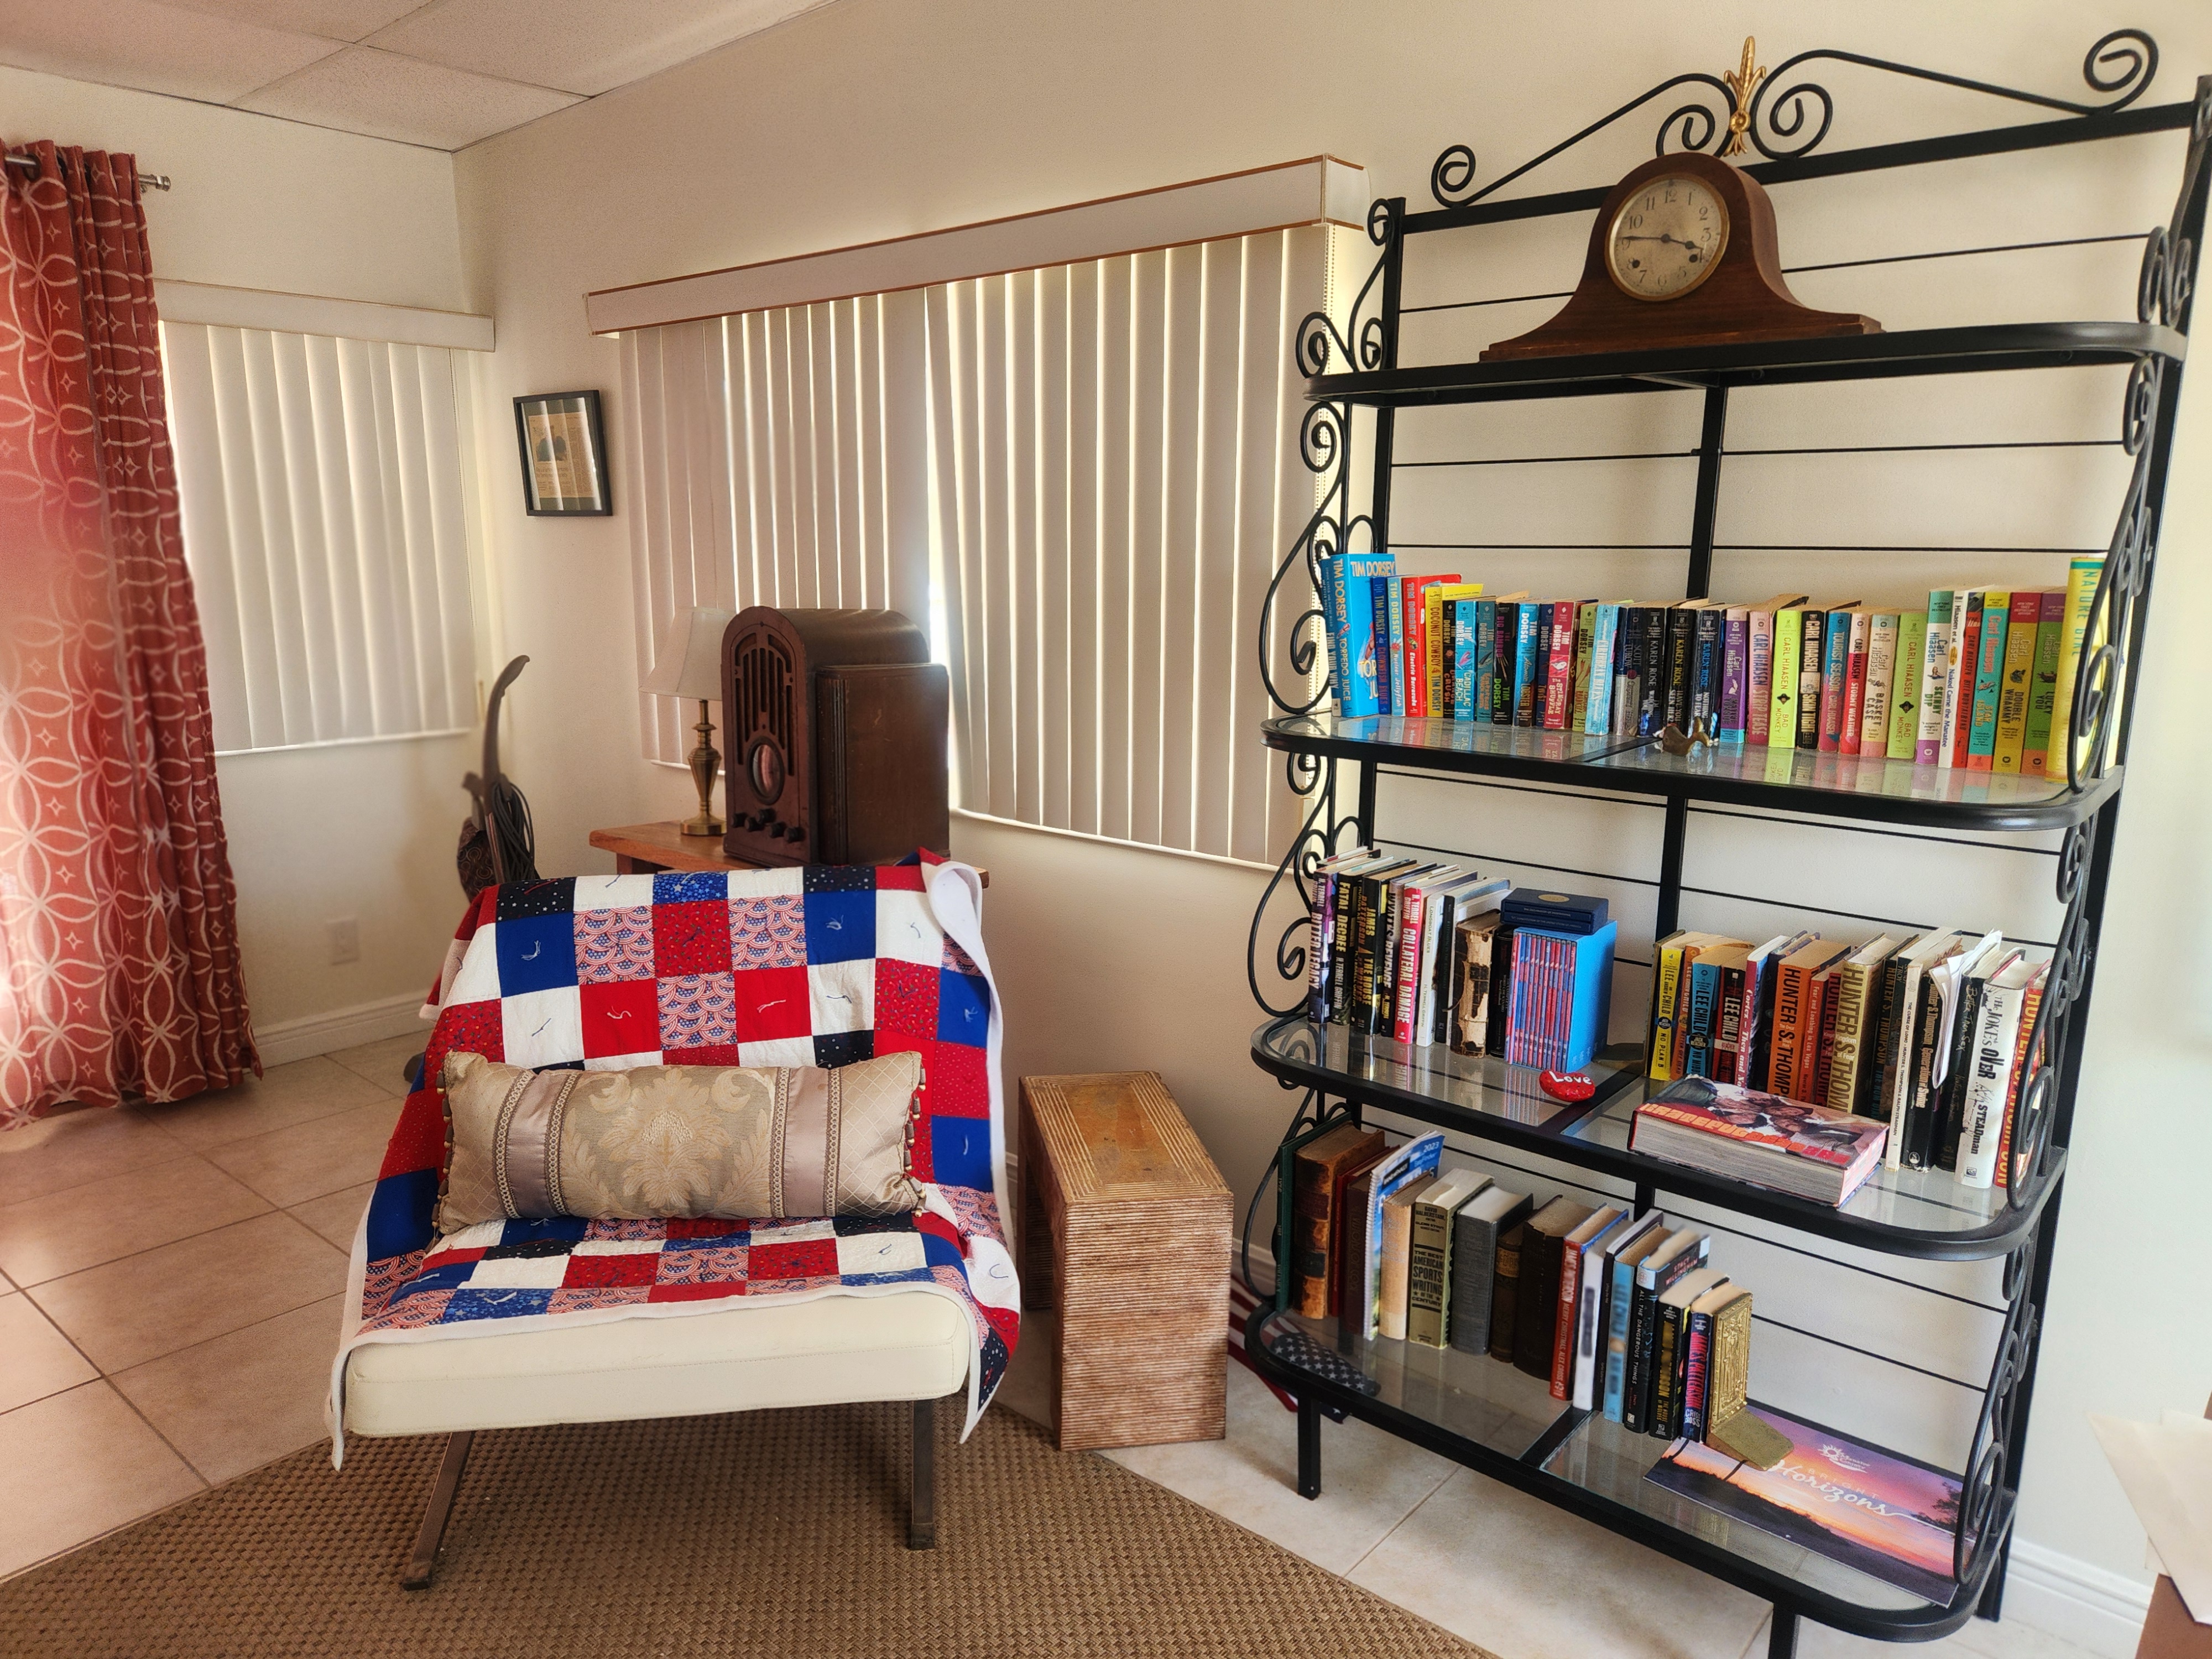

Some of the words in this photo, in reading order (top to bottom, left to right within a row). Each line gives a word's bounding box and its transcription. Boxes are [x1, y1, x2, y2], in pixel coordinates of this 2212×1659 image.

[1646, 196, 1655, 210] 11
[1665, 189, 1677, 204] 12
[1688, 191, 1692, 205] 1
[1629, 215, 1642, 229] 10
[1699, 207, 1708, 221] 2
[1701, 227, 1711, 242] 3
[1639, 270, 1647, 283] 7
[1658, 274, 1667, 286] 6
[1677, 267, 1688, 279] 5
[1334, 559, 1343, 578] TIM
[1350, 561, 1366, 577] TIM
[1366, 561, 1395, 576] DORSEY
[1335, 581, 1347, 623] DORSEY
[1521, 613, 1529, 644] DORSEY
[1806, 620, 1820, 639] CARL
[1950, 606, 1961, 630] Hiaasen
[1456, 620, 1464, 645] DORSEY
[1552, 624, 1562, 651] DORSEY
[1562, 631, 1571, 645] TIM
[1579, 629, 1588, 654] DORSEY
[1753, 634, 1768, 652] CARL
[1339, 638, 1350, 676] TORPEDO
[1650, 640, 1658, 665] KAREN
[1675, 639, 1684, 665] KAREN
[1702, 643, 1711, 666] KAREN
[1782, 637, 1791, 656] CARL
[1804, 640, 1819, 671] HIAASEN
[1832, 632, 1845, 661] TOURIST
[1854, 638, 1863, 653] CARL
[1907, 641, 1917, 661] CARL
[1927, 633, 1940, 662] Hiaasen
[2008, 631, 2024, 663] Hiaasen
[1594, 640, 1609, 676] CARIBBEAN
[1726, 650, 1736, 677] Hiaasen
[1753, 654, 1768, 686] HIAASEN
[1851, 654, 1862, 679] HIAASEN
[1648, 668, 1657, 686] ROSE
[1673, 667, 1682, 686] ROSE
[1700, 667, 1709, 687] ROSE
[1781, 658, 1790, 690] HIAASEN
[1829, 662, 1843, 692] SEASON
[1903, 665, 1915, 697] HIAASEN
[1342, 678, 1350, 701] JUICE
[1463, 672, 1472, 707] CADILLAC
[1520, 683, 1530, 707] LOBSTER
[1554, 683, 1563, 714] STINGRAY
[1592, 679, 1604, 701] BLUES
[1752, 690, 1767, 713] STRIP
[1828, 695, 1838, 708] CARL
[1848, 682, 1859, 708] STORMY
[1934, 686, 1943, 714] SKINNY
[1702, 692, 1710, 718] NOTHING
[1802, 694, 1816, 711] SKIN
[1864, 698, 1875, 719] CASE
[1875, 692, 1885, 726] BASKET
[2001, 688, 2015, 724] WHAMMY
[2010, 691, 2024, 722] DOUBLE
[1752, 714, 1767, 735] TEASE
[1801, 713, 1815, 733] TIGHT
[1826, 708, 1837, 735] HIAASEN
[1846, 709, 1856, 738] WEATHER
[1895, 716, 1903, 742] MONKEY
[1941, 718, 1951, 748] Manatee
[1338, 881, 1350, 910] FATAL
[1366, 907, 1376, 937] JAMES
[1386, 893, 1396, 937] WYATT'S
[1310, 912, 1323, 952] BITTER
[1336, 914, 1348, 953] DECREE
[1364, 958, 1374, 974] THE
[1383, 941, 1394, 989] REVENGE
[1400, 927, 1416, 982] COLLATERAL
[1308, 952, 1321, 989] LEGACY
[1334, 964, 1344, 985] TERRELL
[1333, 985, 1343, 1009] GRIFFIN
[1361, 975, 1373, 1006] HOUSE
[1695, 990, 1710, 1007] LEE
[1778, 968, 1801, 1025] HUNTER
[1963, 984, 1978, 1012] Better
[1397, 985, 1412, 1024] DAMAGE
[1724, 997, 1740, 1015] LEE
[1693, 1007, 1708, 1031] CHILD
[1722, 1015, 1739, 1041] CHILD
[1807, 1010, 1817, 1034] Loathing
[1922, 1013, 1938, 1045] Thompson
[1965, 1015, 1974, 1031] Than
[1778, 1030, 1795, 1042] S.
[1955, 1034, 1971, 1052] Sex
[1804, 1052, 1813, 1069] Vegas
[1918, 1045, 1934, 1085] Generation
[1976, 1047, 2004, 1080] OVER
[1549, 1071, 1592, 1084] Love
[1916, 1085, 1927, 1108] Swine
[1639, 1103, 1749, 1138] GRATEFUL
[1971, 1104, 1988, 1155] STEADman
[1423, 1141, 1439, 1154] 2023
[1413, 1266, 1443, 1283] SPORTS
[1414, 1255, 1443, 1270] AMERICAN
[1666, 1259, 1698, 1286] WILLINGHAM
[1673, 1256, 1691, 1272] STACY
[1412, 1278, 1442, 1296] WRITING
[1412, 1297, 1442, 1307] CENTURY
[1561, 1303, 1569, 1321] MERRY
[1558, 1322, 1568, 1350] CHRISTMAS,
[1689, 1332, 1708, 1362] JAMES
[1555, 1366, 1565, 1381] CROSS
[1686, 1361, 1705, 1409] PATTERSON
[1685, 1416, 1700, 1427] CROSS
[1686, 1408, 1700, 1419] CRISS
[1840, 1458, 1865, 1469] County
[1841, 1453, 1870, 1467] Manatee
[1764, 1459, 1885, 1516] Horizons
[1808, 1468, 1880, 1499] BRIGHT
